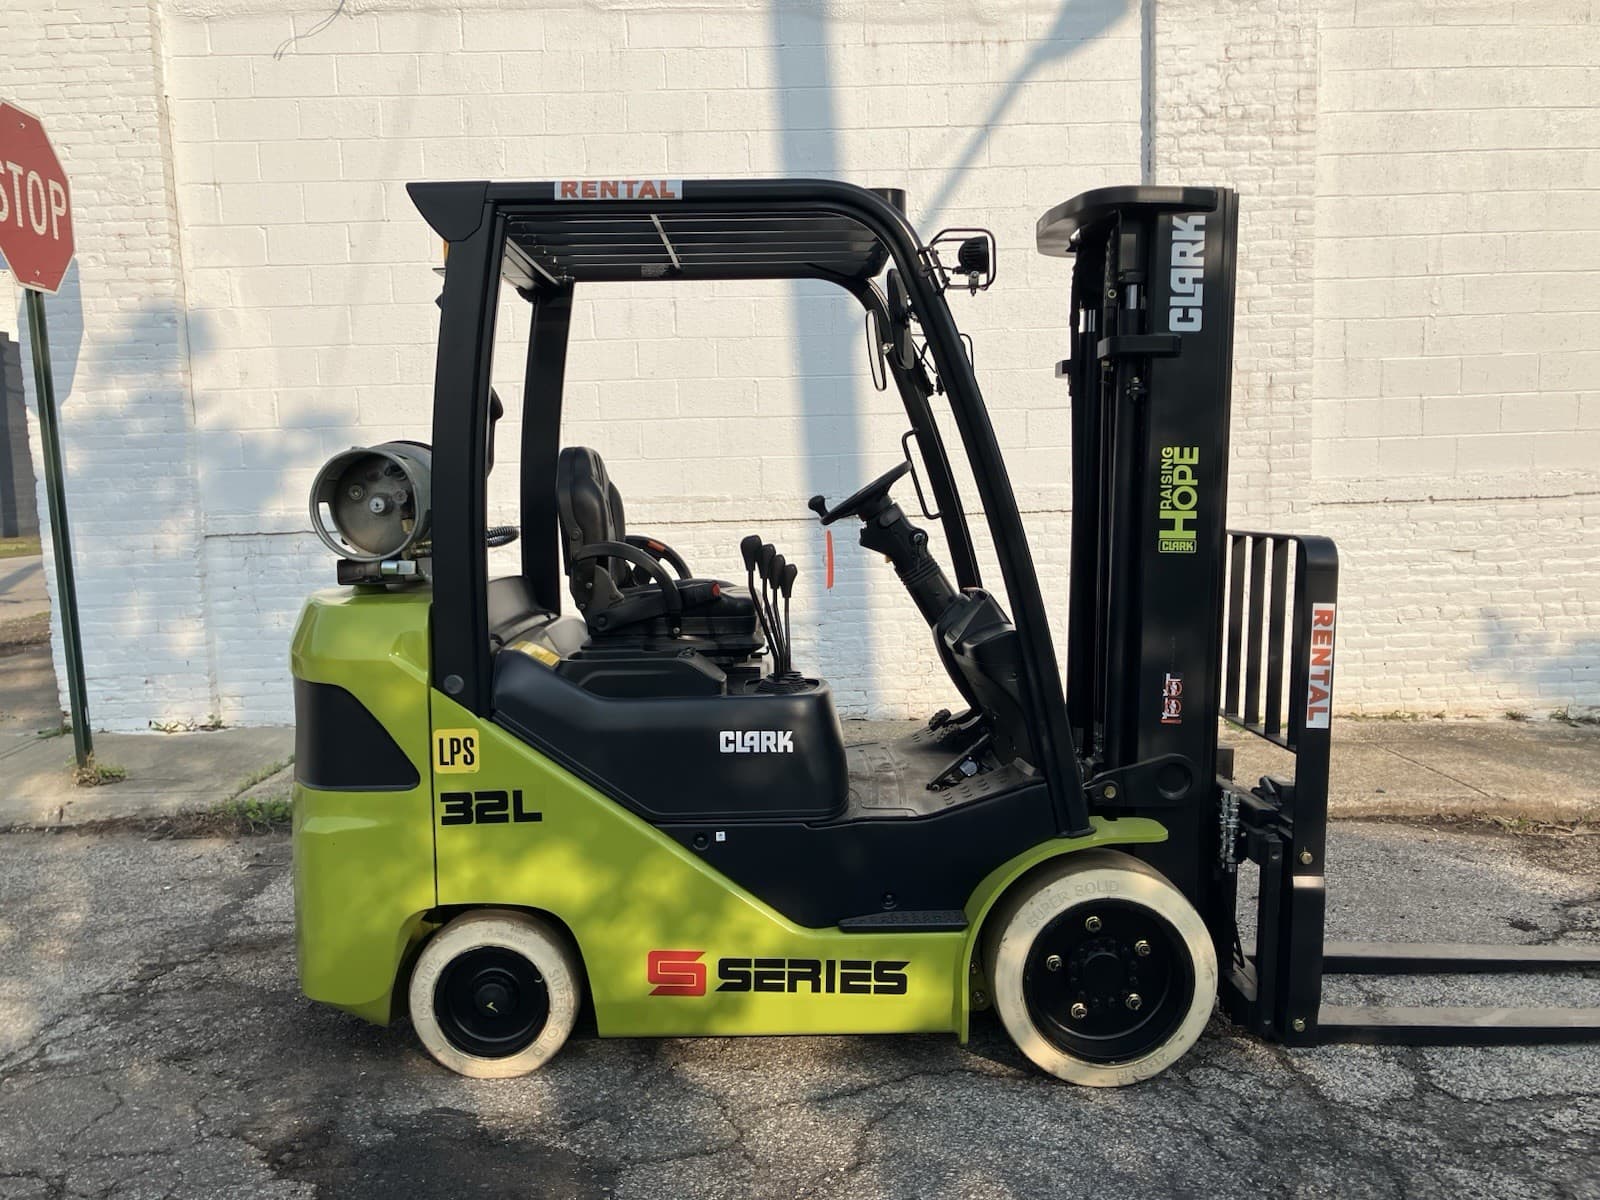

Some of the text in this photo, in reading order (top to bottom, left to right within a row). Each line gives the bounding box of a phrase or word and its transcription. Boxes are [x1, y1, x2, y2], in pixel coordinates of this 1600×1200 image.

[560, 180, 675, 199] RENTAL
[1168, 215, 1206, 332] CLARK
[1159, 446, 1174, 510] RAISING
[1159, 446, 1199, 539] HOPE
[1161, 541, 1194, 551] CLARK
[1307, 609, 1334, 721] RENTAL
[438, 736, 475, 766] LPS
[719, 730, 794, 753] CLARK
[440, 790, 543, 825] 32L
[1026, 879, 1120, 928] SUPER SOLID
[714, 958, 911, 995] SERIES
[532, 968, 567, 1058] SUPER SOLID
